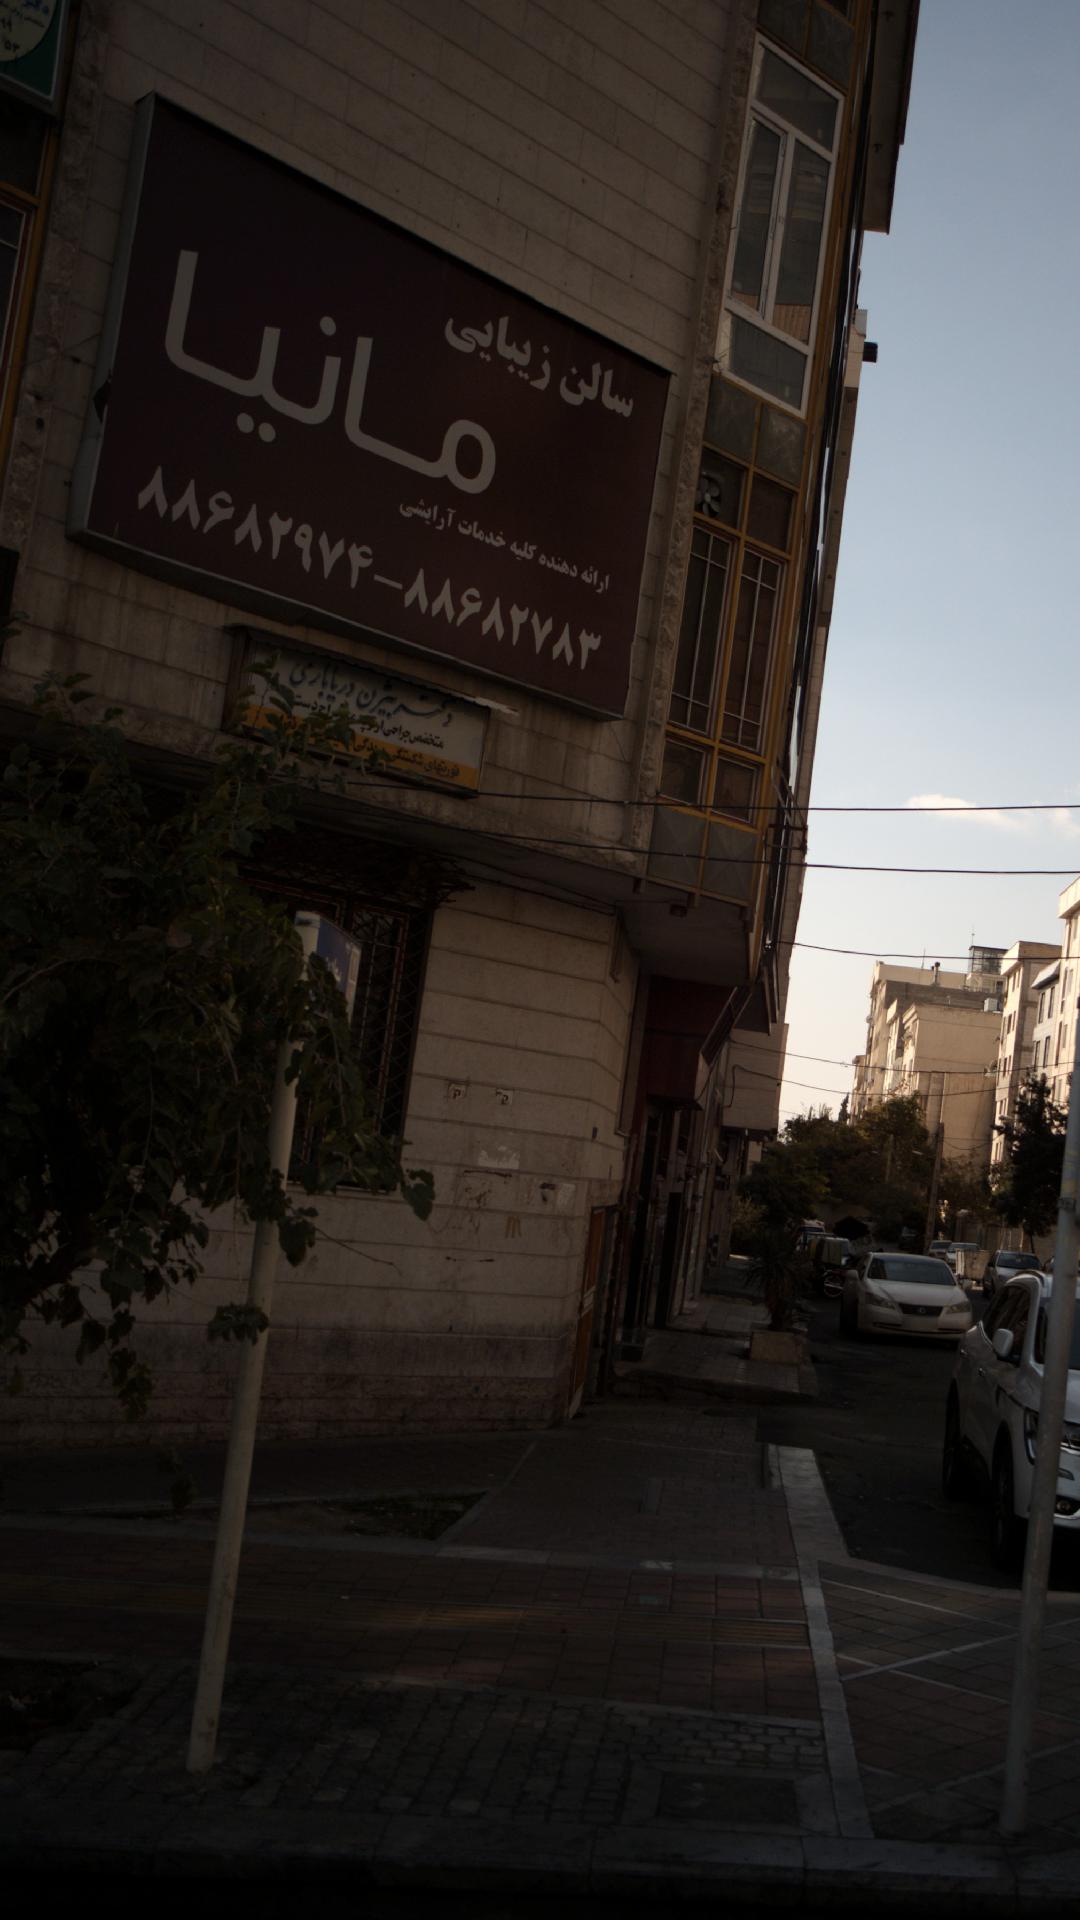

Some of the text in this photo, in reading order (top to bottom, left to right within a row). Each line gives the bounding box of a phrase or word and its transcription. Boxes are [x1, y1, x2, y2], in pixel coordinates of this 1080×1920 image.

[163, 248, 497, 496] مانیا
[444, 315, 634, 419] سالن زیبایی
[399, 498, 611, 594] ارائه دهنده کلیه خدمات آرایشی
